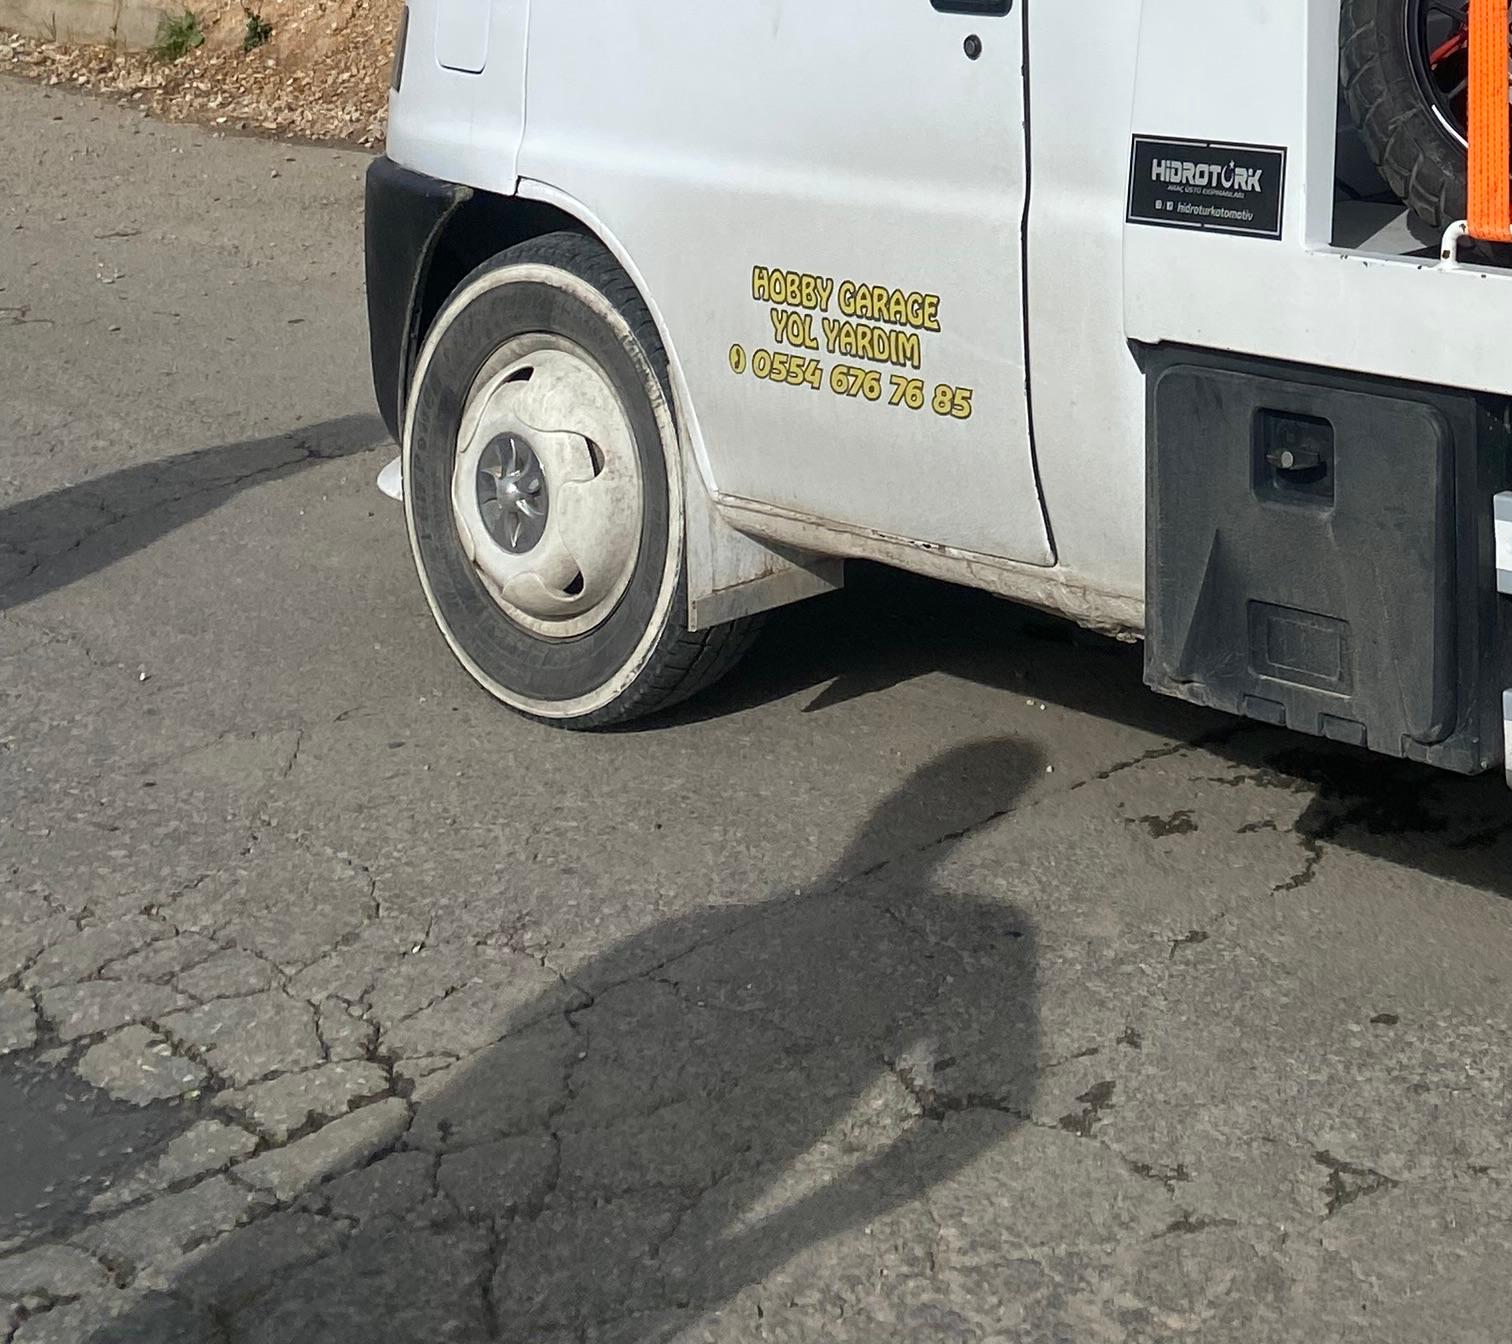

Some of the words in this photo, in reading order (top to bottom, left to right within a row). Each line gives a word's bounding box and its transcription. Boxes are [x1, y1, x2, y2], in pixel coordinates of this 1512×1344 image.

[752, 265, 834, 313] HOBBY
[837, 280, 942, 333] GARAGE
[770, 308, 820, 351] YOL
[821, 316, 922, 370] YARDIM
[751, 349, 824, 390] 0554
[829, 363, 882, 401] 676
[887, 374, 925, 410] 76
[931, 383, 974, 420] 85
